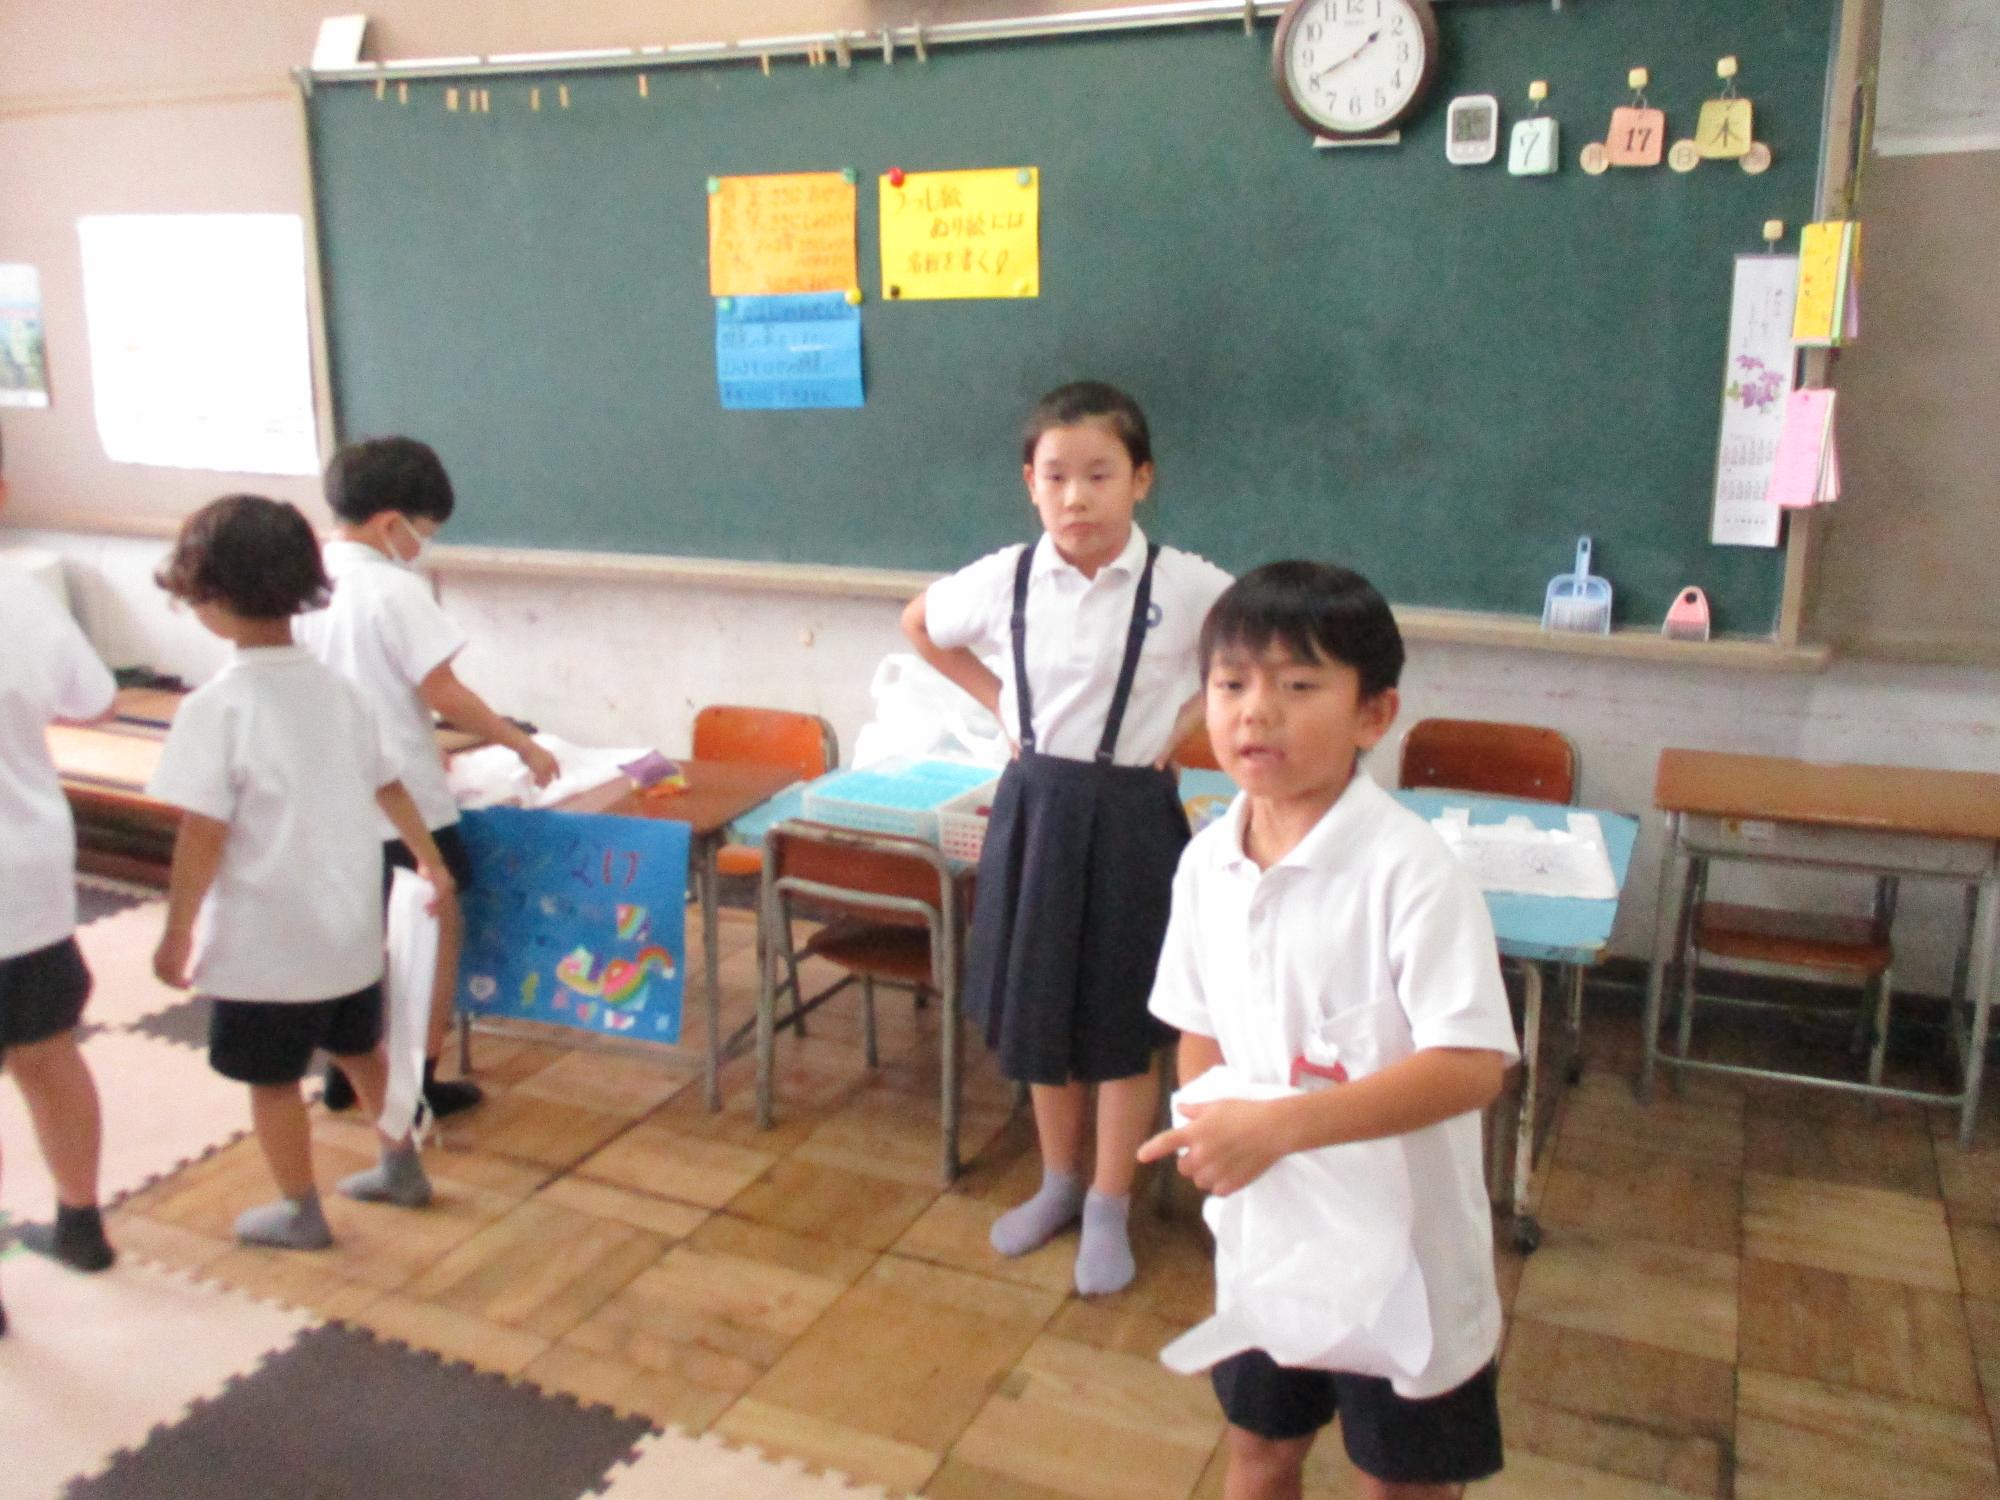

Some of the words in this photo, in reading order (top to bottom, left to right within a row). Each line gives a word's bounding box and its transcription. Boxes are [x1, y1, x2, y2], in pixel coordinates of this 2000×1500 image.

[1323, 1, 1337, 21] 11
[1344, 0, 1365, 13] 12
[1305, 23, 1323, 42] 10
[1391, 14, 1404, 35] 2
[1302, 48, 1315, 68] 9
[1395, 41, 1409, 62] 3
[1308, 72, 1321, 92] 8
[1390, 68, 1402, 89] 4
[1325, 91, 1338, 111] 7
[1348, 96, 1362, 116] 6
[1374, 87, 1387, 107] 5
[1625, 127, 1653, 152] 17
[1709, 116, 1744, 149] 木
[1519, 130, 1542, 167] 7
[929, 209, 1025, 239] ぬり絵には
